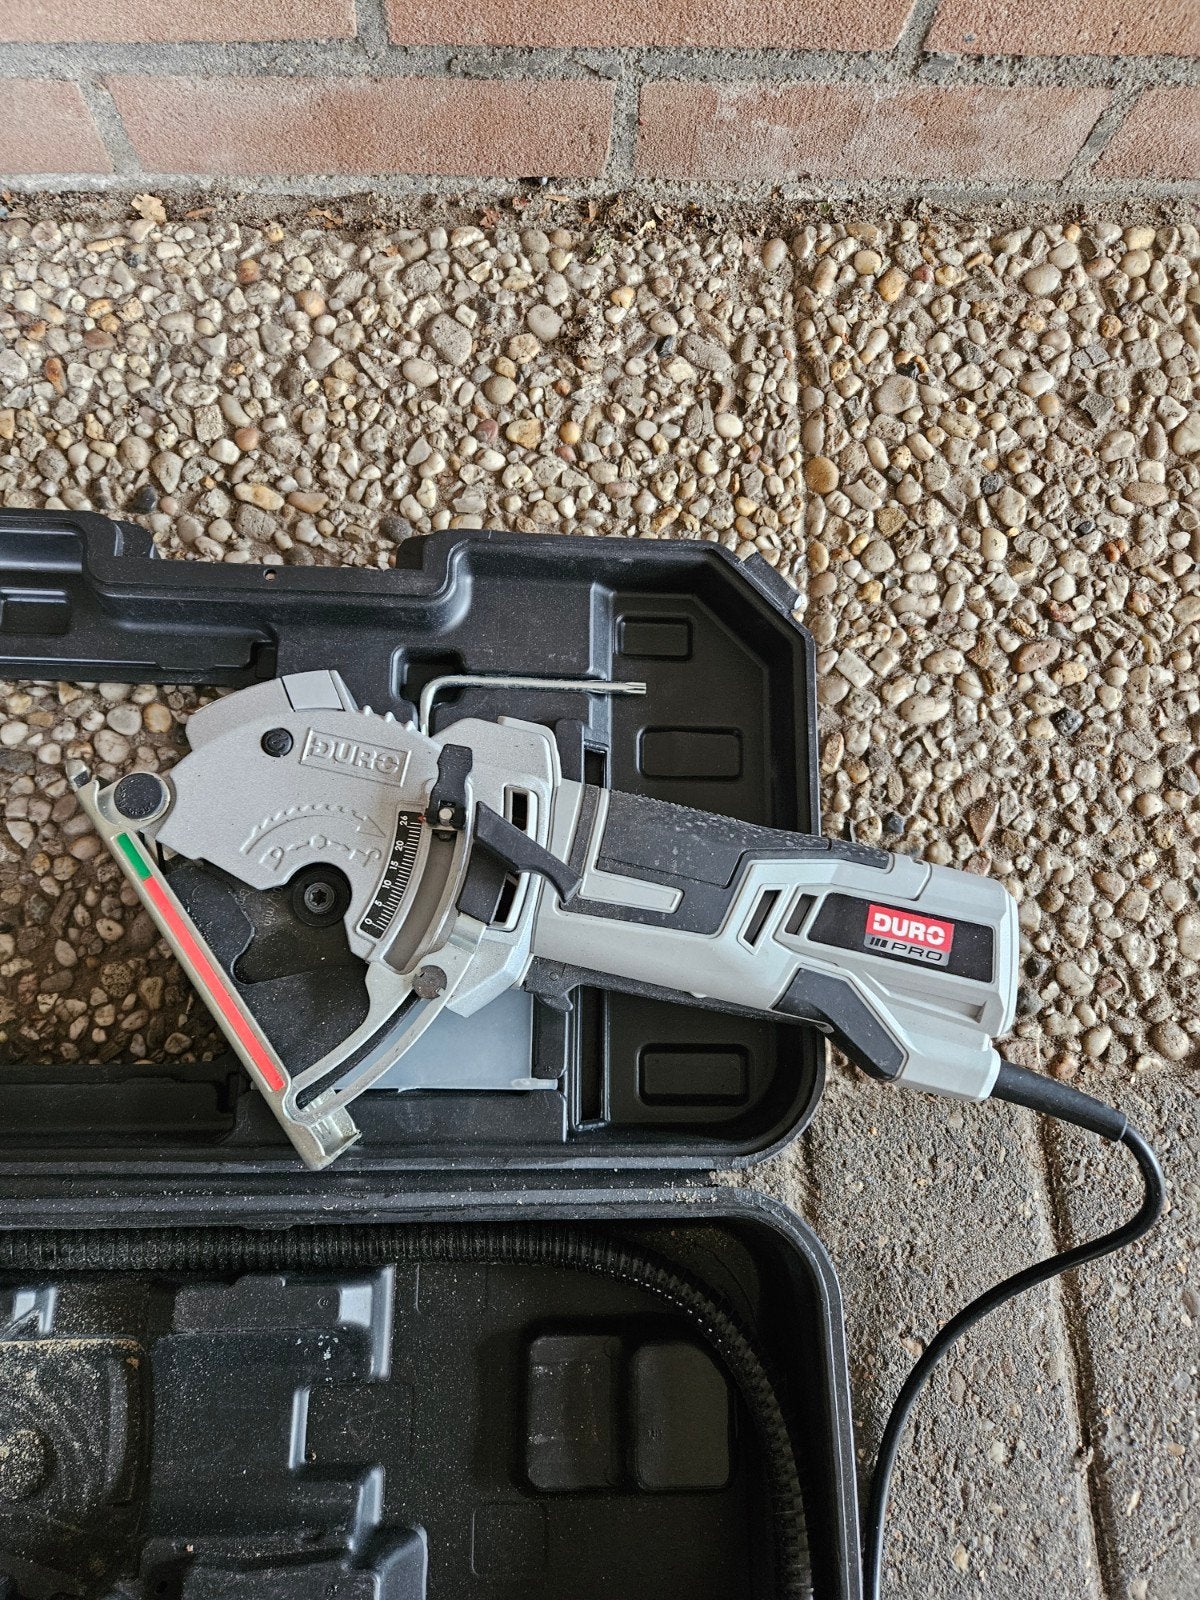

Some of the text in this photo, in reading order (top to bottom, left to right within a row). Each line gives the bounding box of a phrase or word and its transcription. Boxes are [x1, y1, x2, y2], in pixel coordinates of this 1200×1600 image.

[309, 737, 400, 775] DURO
[364, 815, 409, 925] 0 5 10 15 20 26
[872, 912, 946, 946] DURO
[891, 942, 943, 962] PRO
